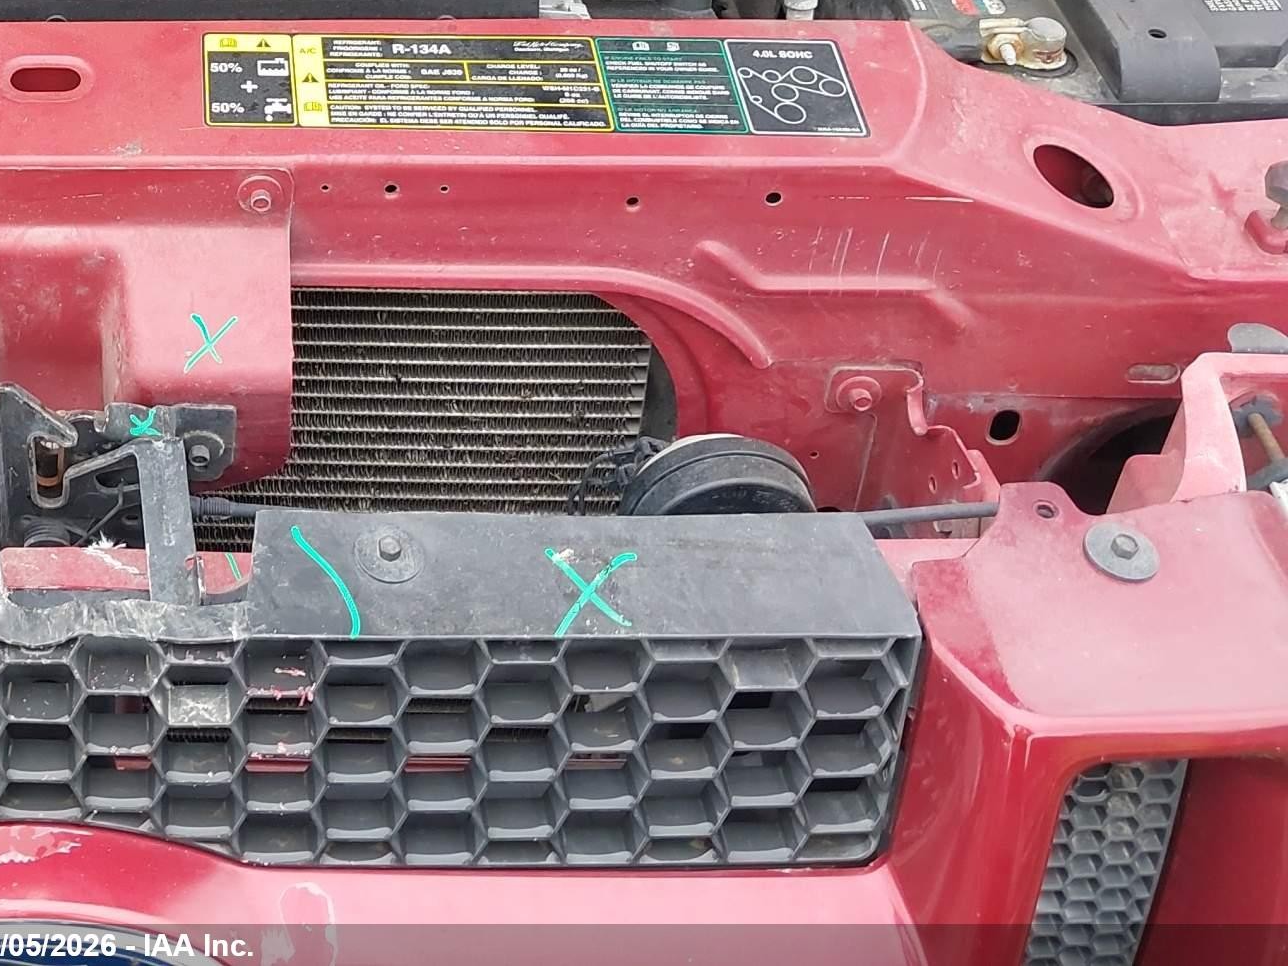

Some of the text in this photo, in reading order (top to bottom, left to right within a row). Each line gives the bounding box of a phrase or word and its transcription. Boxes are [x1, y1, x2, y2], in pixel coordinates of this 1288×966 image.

[392, 43, 452, 55] R-134A
[752, 50, 814, 59] 4.0L SOHC
[210, 62, 244, 73] 50%
[212, 102, 246, 114] 50%
